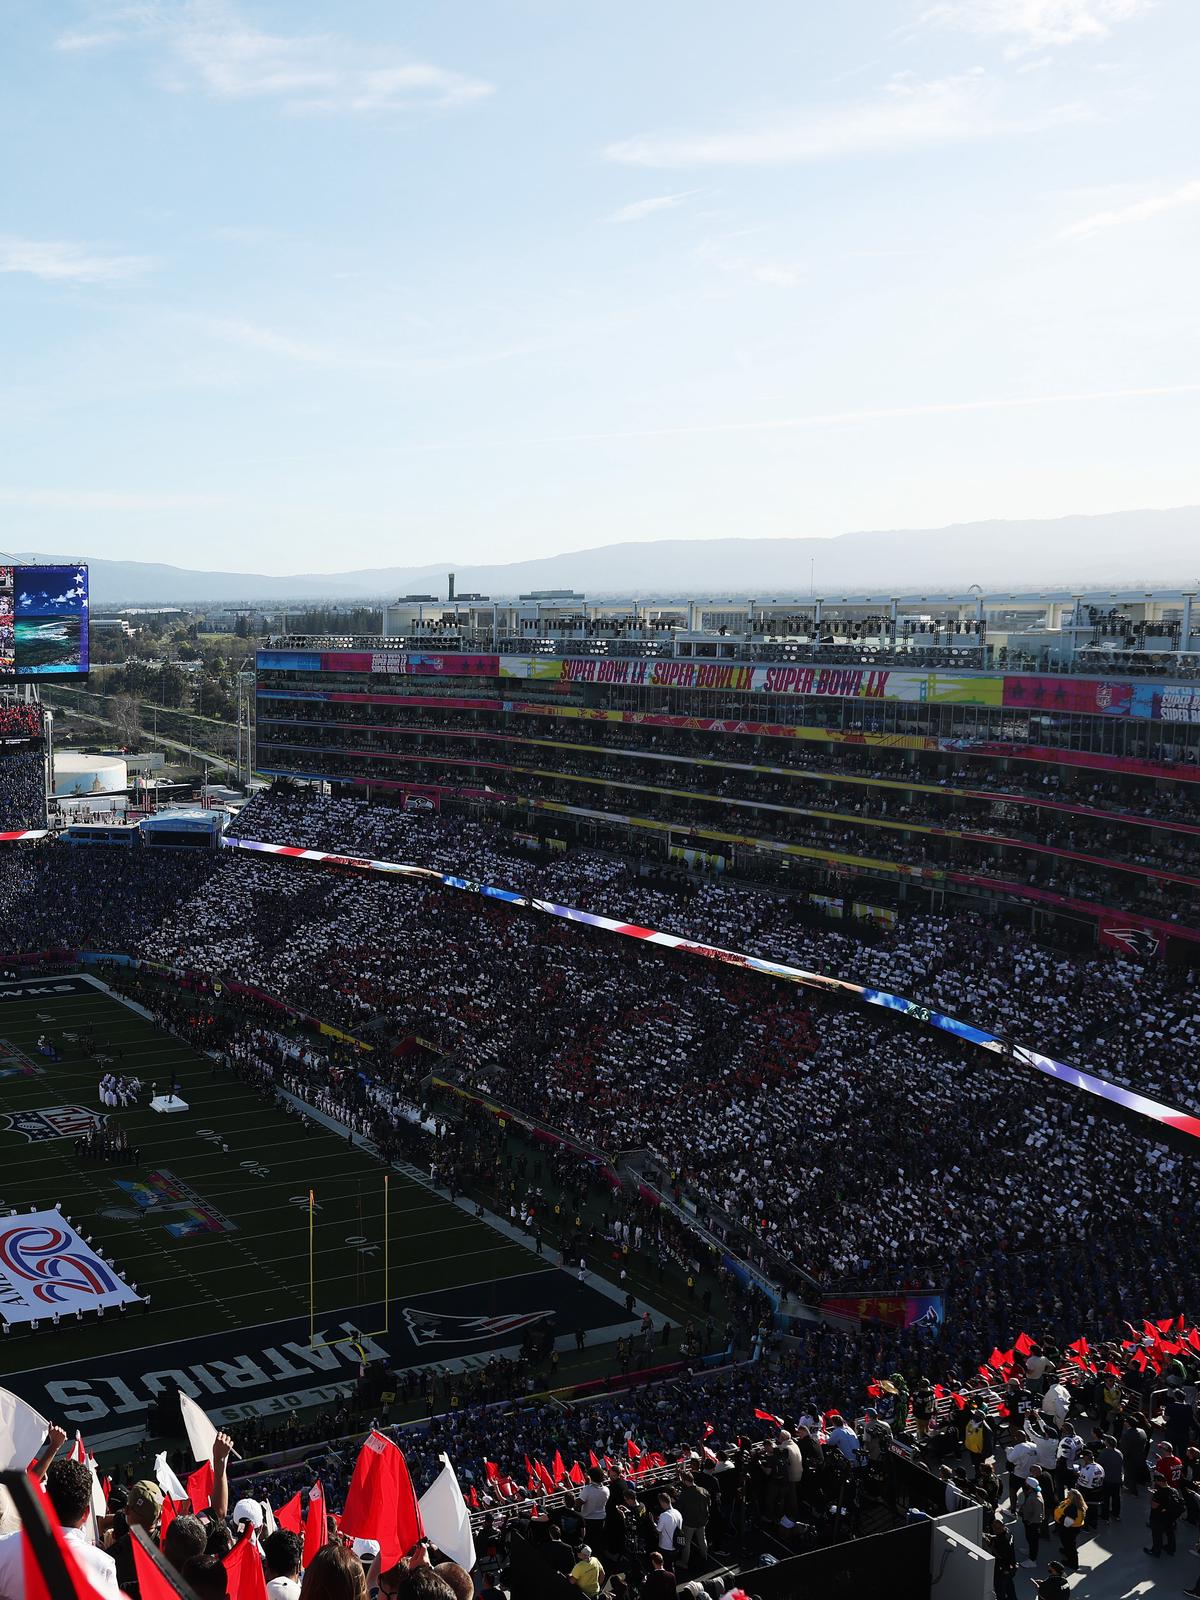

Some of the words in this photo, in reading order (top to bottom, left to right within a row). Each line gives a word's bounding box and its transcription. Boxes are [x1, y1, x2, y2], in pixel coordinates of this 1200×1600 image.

[560, 658, 596, 681] SUPER
[596, 661, 628, 684] BOWL
[628, 662, 646, 684] LX
[651, 661, 695, 687] SUPER
[696, 664, 735, 689] BOWL
[736, 666, 757, 690] LX
[763, 666, 814, 695] SUPER
[816, 669, 864, 697] BOWL
[865, 671, 891, 698] LX
[1160, 708, 1190, 722] SUPER
[44, 1320, 392, 1422] PATRIOTS
[221, 1404, 258, 1422] US
[269, 1394, 301, 1412] OF
[1171, 1469, 1182, 1482] 23
